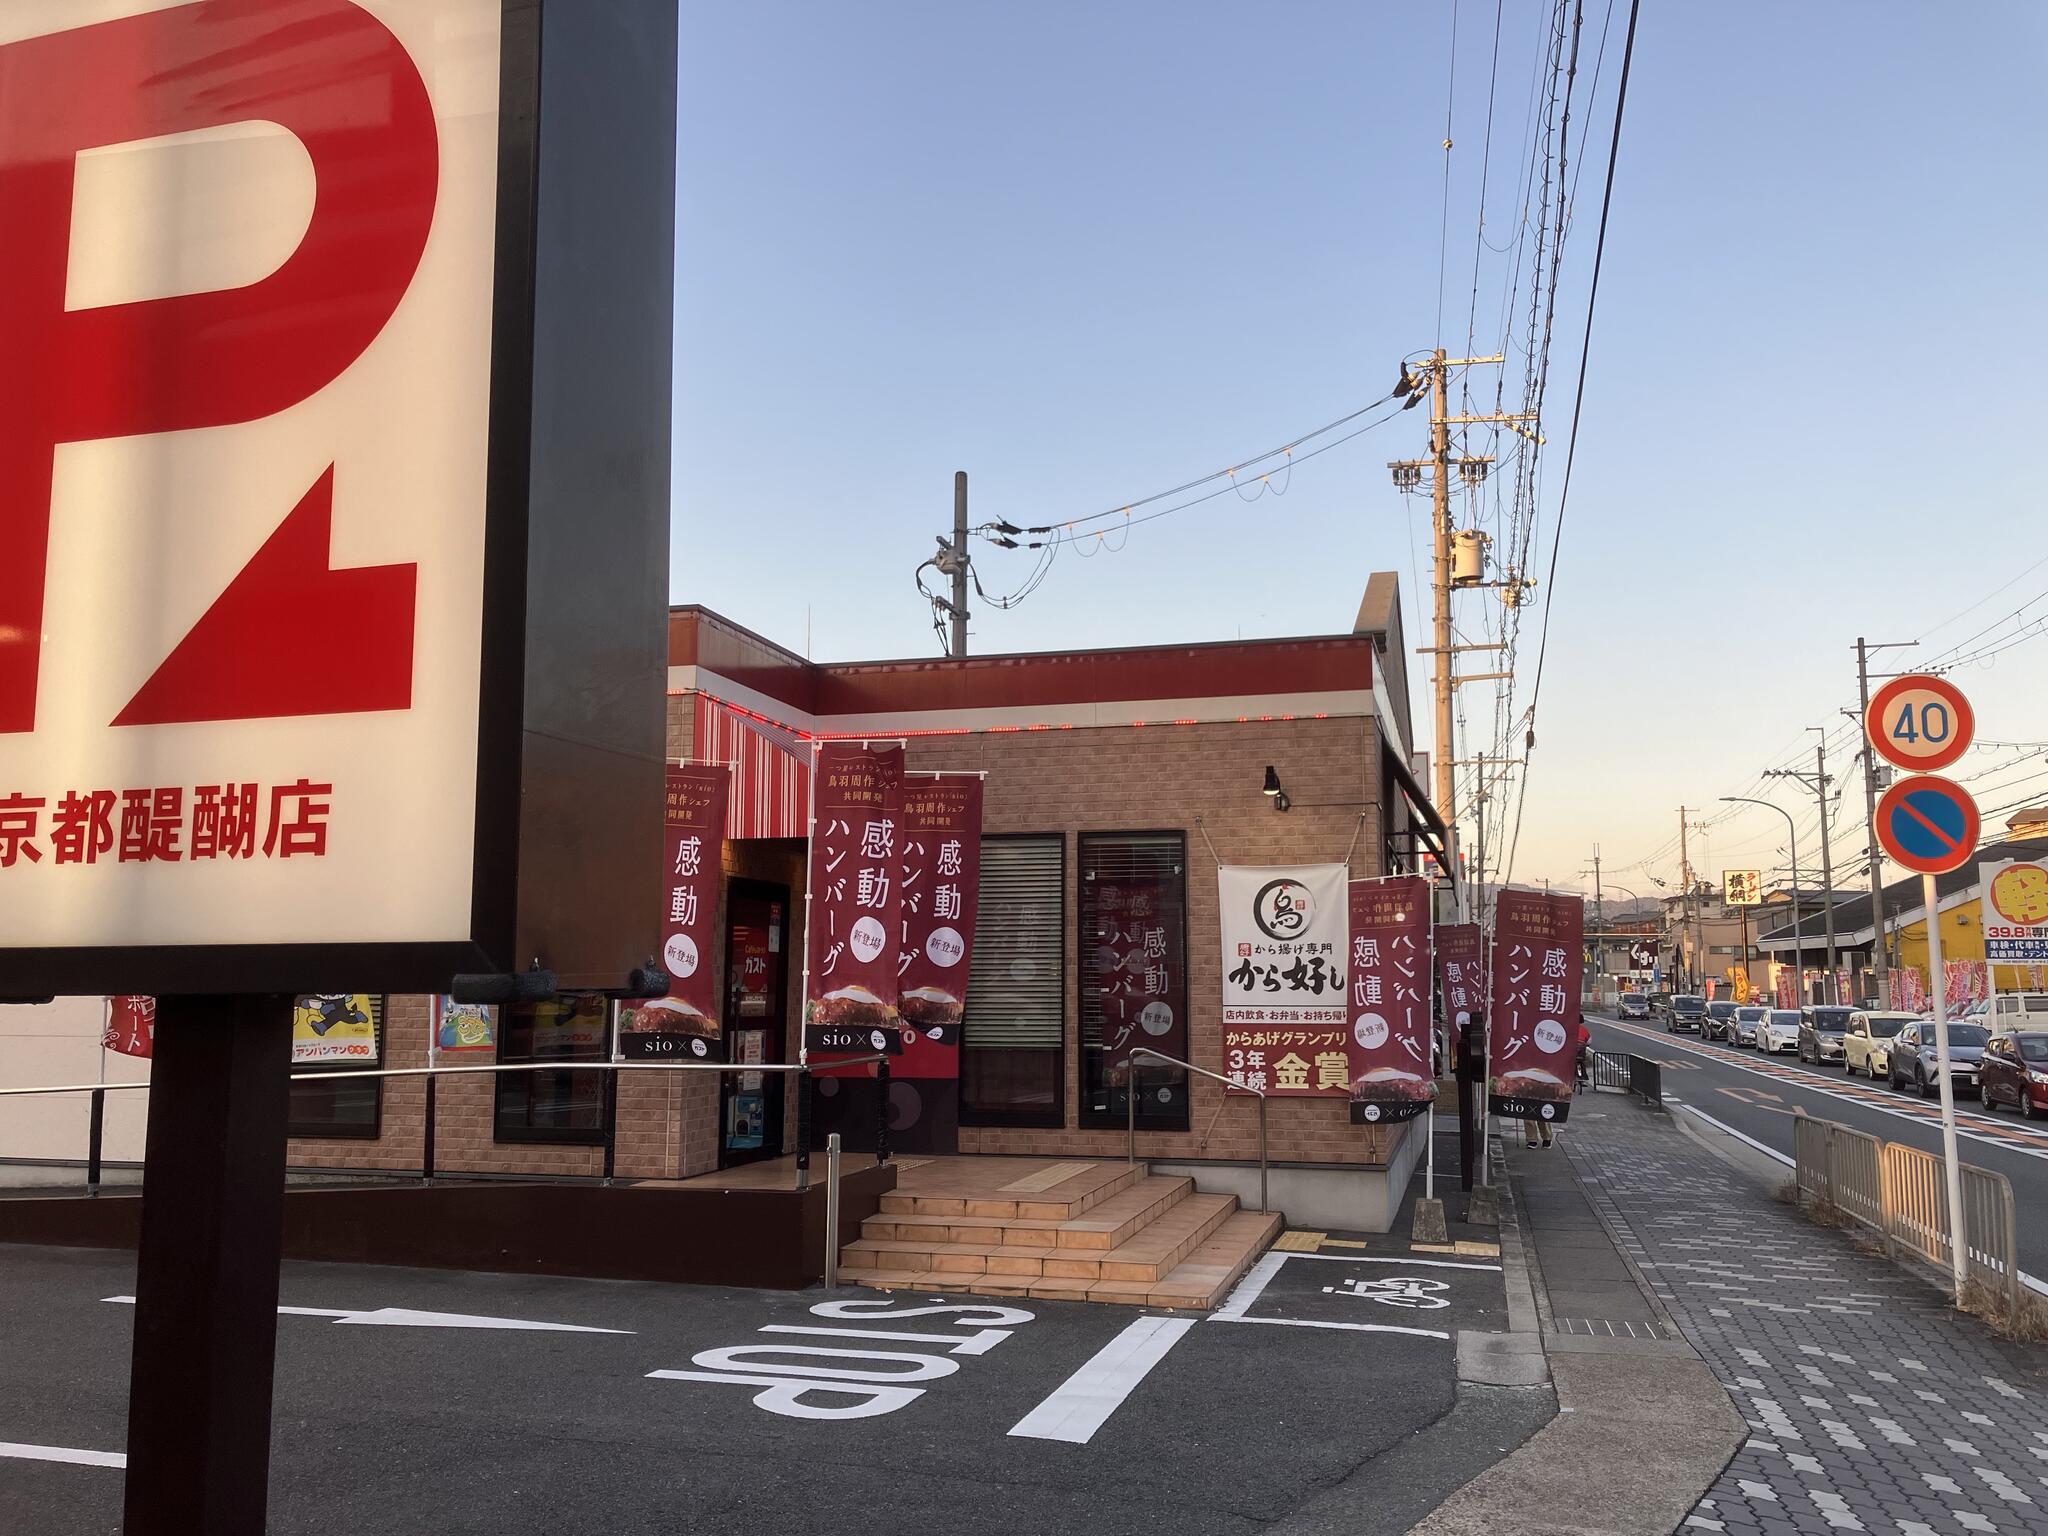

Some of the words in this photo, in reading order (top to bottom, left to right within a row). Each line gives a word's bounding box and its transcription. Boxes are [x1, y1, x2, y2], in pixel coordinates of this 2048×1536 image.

[1893, 702, 1949, 743] 40
[665, 810, 693, 820] 同開発
[669, 836, 702, 926] 感動
[857, 818, 895, 909] 感動
[933, 839, 962, 920] 感動
[821, 819, 850, 977] ハンバーグ
[1746, 872, 1757, 902] ラーメン
[897, 841, 925, 977] ハンバーグ
[744, 956, 767, 974] ガスト
[1143, 926, 1168, 995] 感動
[1255, 942, 1333, 955] から揚げ専門
[1109, 930, 1136, 1050] ハンバーグ
[1228, 956, 1345, 996] から好し
[1539, 948, 1567, 1015] 感動
[1502, 944, 1532, 1061] ハンバーグ
[645, 1035, 673, 1051] sio
[822, 1029, 851, 1046] sio
[1226, 1031, 1346, 1046] からあげグランプリ
[1229, 1049, 1266, 1069] 3年
[1272, 1051, 1350, 1090] 金賞
[1226, 1070, 1267, 1091] 連続
[1502, 1099, 1525, 1113] sio
[644, 1300, 1036, 1419] STOP
